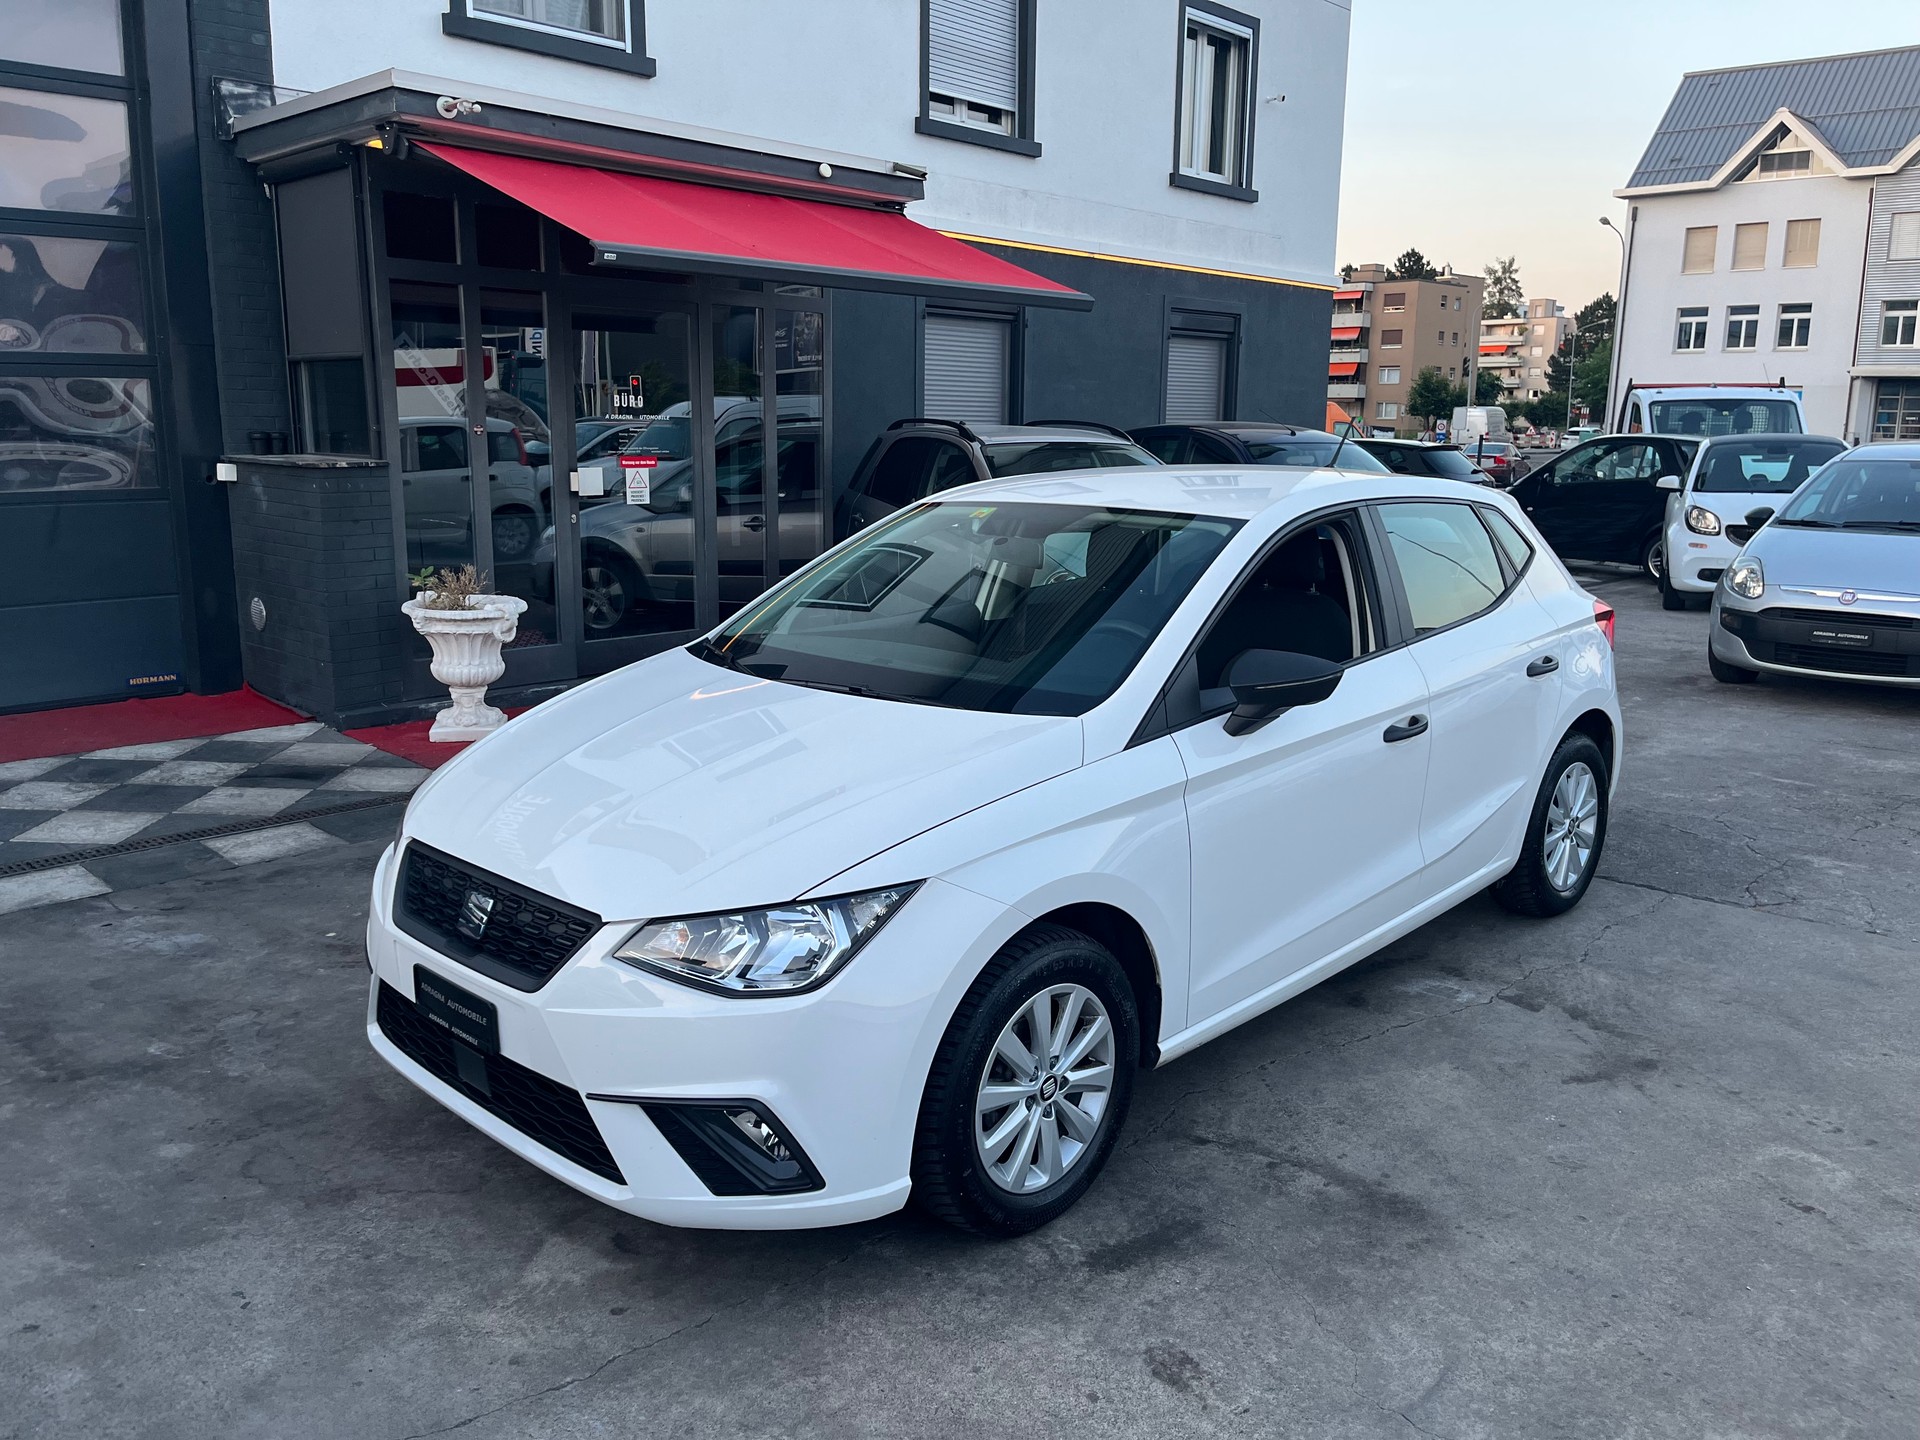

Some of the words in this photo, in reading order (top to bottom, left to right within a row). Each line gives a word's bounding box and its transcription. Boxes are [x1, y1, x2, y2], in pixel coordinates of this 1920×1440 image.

[613, 393, 644, 408] BÜRO
[421, 982, 445, 1003] ADRAGNA
[446, 1000, 487, 1026] AUTOMOBILE
[428, 1013, 449, 1029] ADRAGNA
